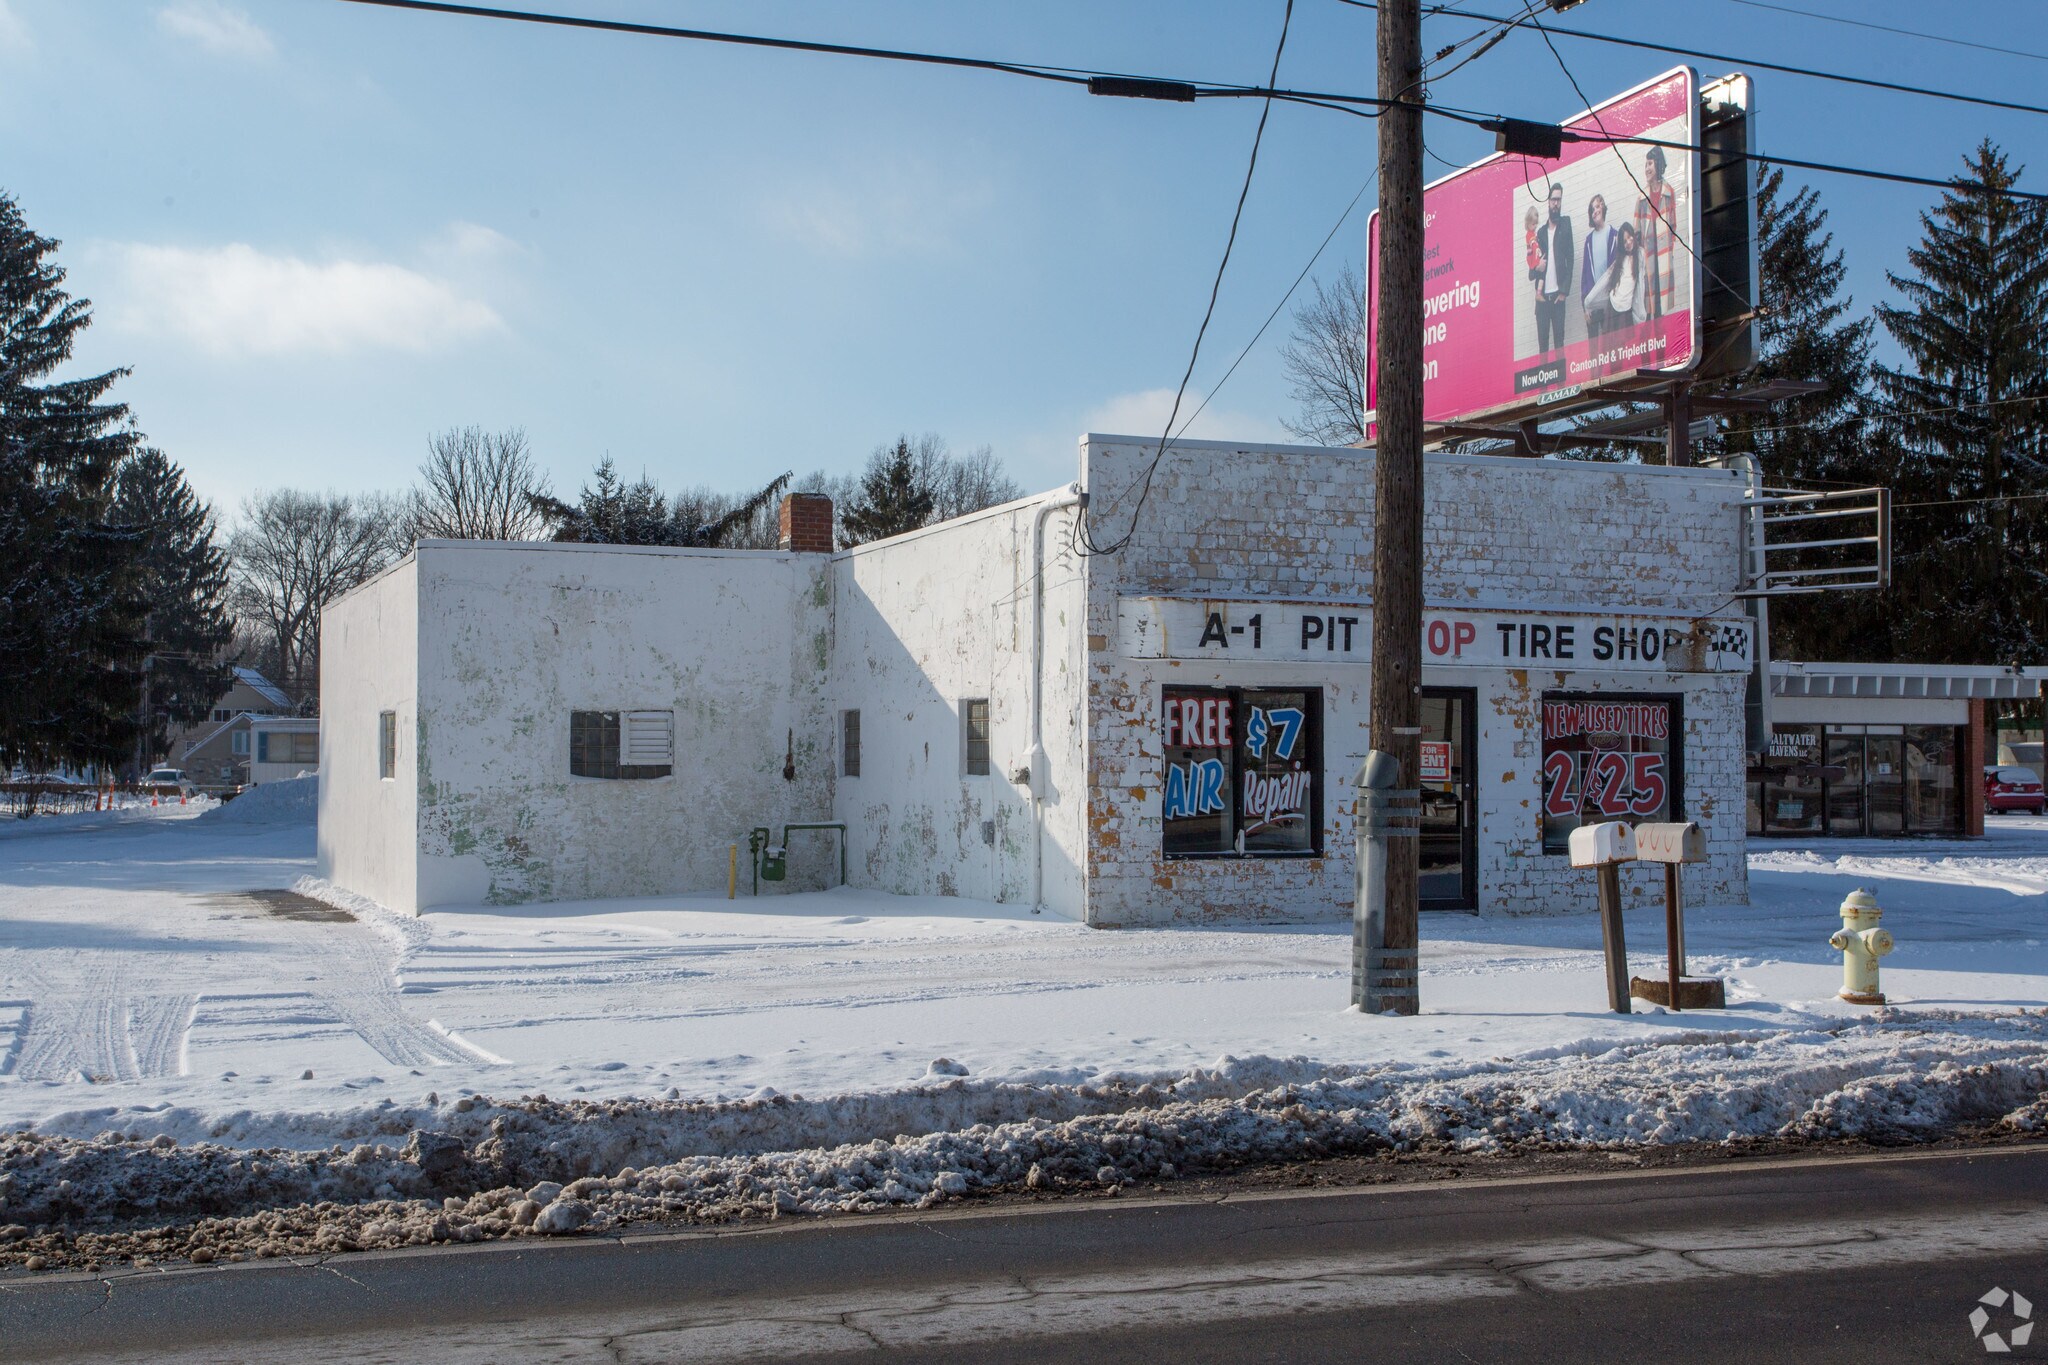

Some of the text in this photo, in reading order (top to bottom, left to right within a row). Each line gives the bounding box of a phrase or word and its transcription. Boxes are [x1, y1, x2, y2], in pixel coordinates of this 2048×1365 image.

[1423, 257, 1455, 282] etwork
[1423, 280, 1480, 319] overing
[1569, 335, 1667, 374] Canton Rd & Triplett Blvd
[1521, 368, 1558, 387] Now Open
[1540, 386, 1577, 403] LAMAR
[1198, 612, 1683, 662] A-1 PIT OP TIRE SHOP
[1164, 697, 1233, 748] FREE
[1245, 705, 1306, 761] $7
[1543, 702, 1580, 740] NEW
[1584, 703, 1624, 734] USED
[1625, 704, 1669, 740] TIRES
[1421, 746, 1437, 754] FOR
[1421, 754, 1446, 767] ENT
[1768, 745, 1799, 757] HAVENS
[1165, 758, 1226, 821] AIR
[1244, 760, 1311, 824] Repair
